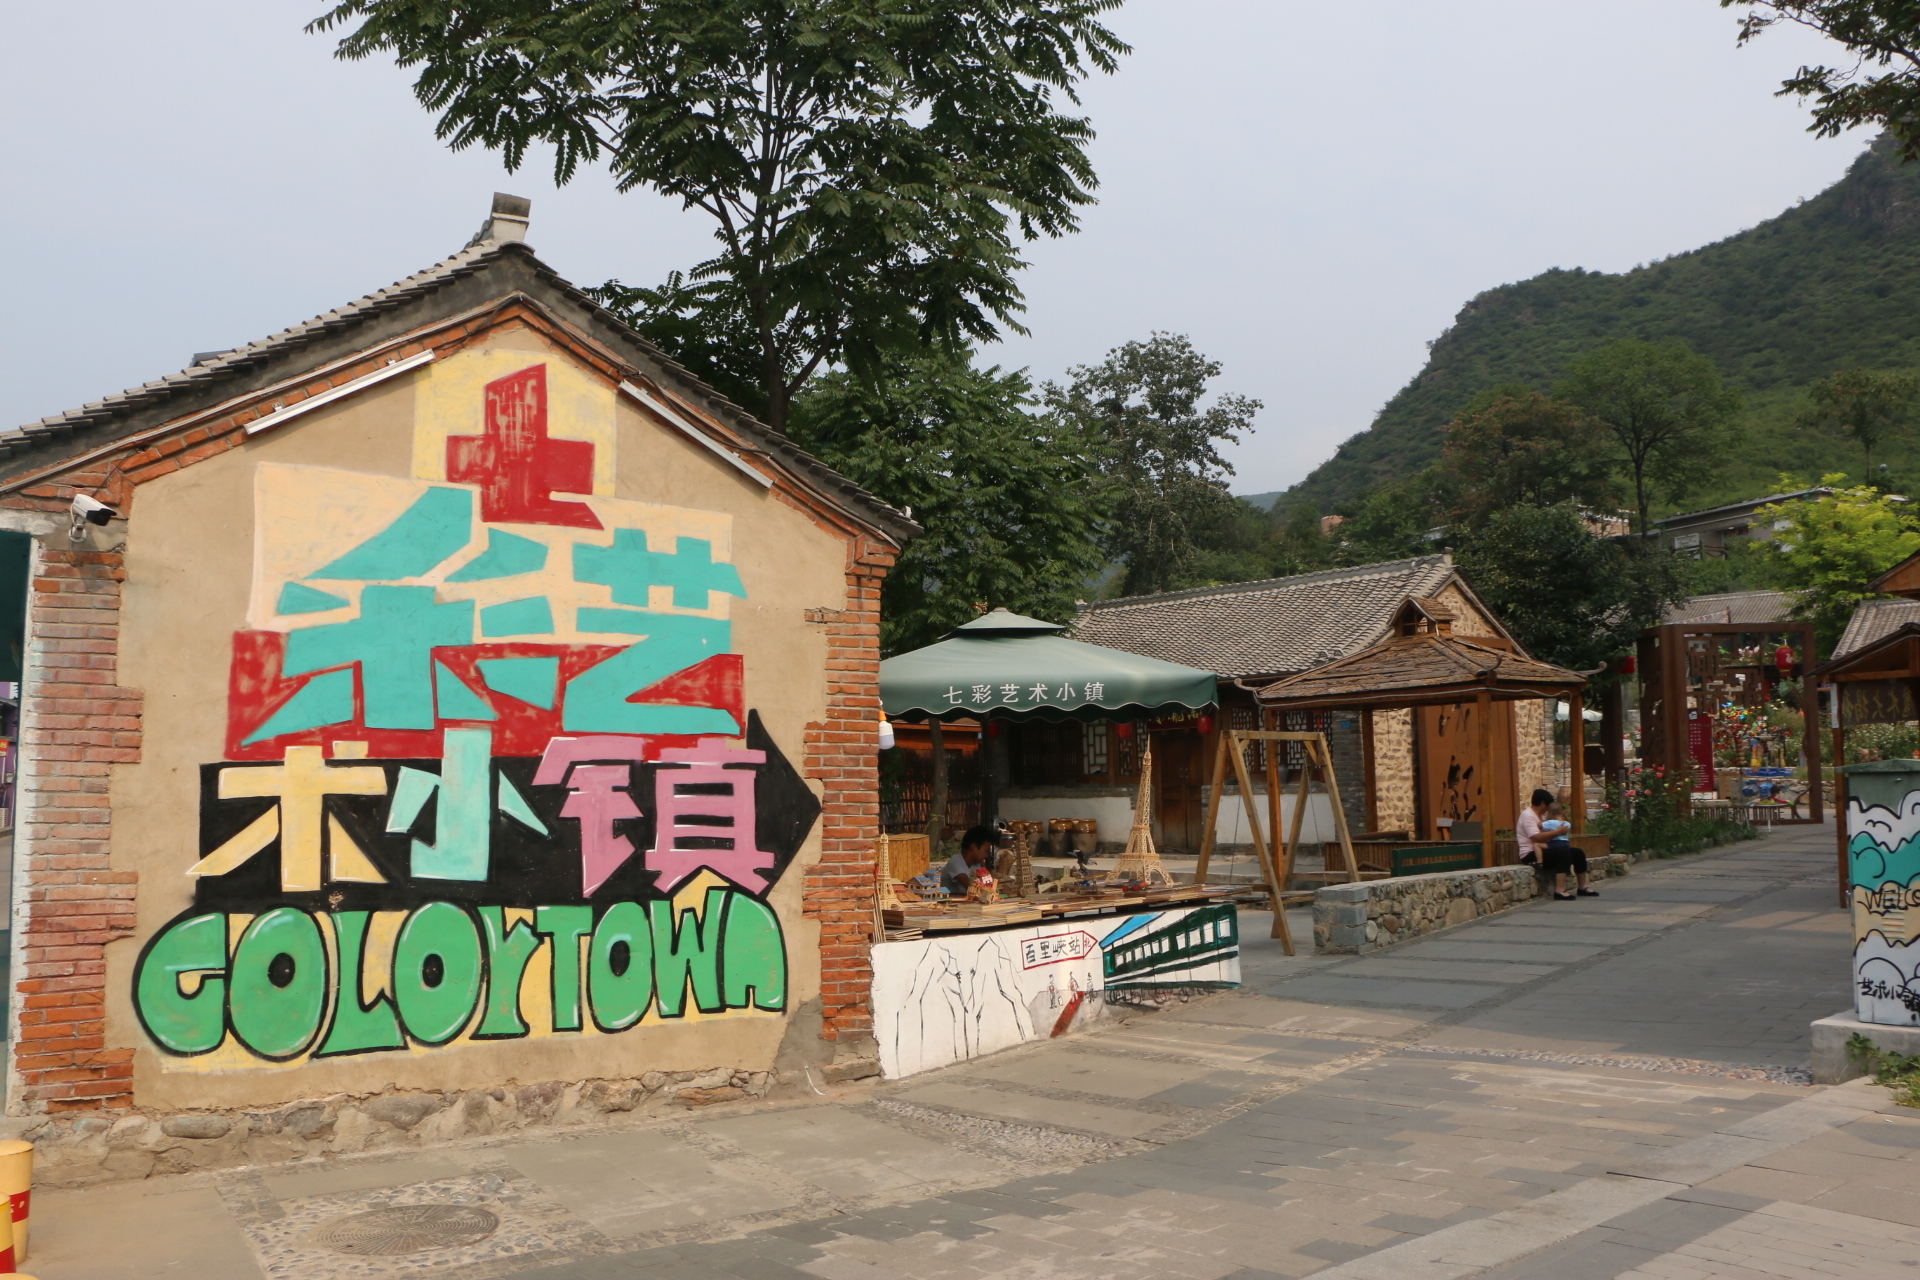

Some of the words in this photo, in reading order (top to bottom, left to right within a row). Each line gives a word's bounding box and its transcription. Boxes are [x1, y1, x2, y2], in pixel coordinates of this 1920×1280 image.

[446, 363, 604, 529] 七
[942, 681, 1105, 705] 七彩艺术小镇
[1025, 935, 1081, 964] 百里峡站
